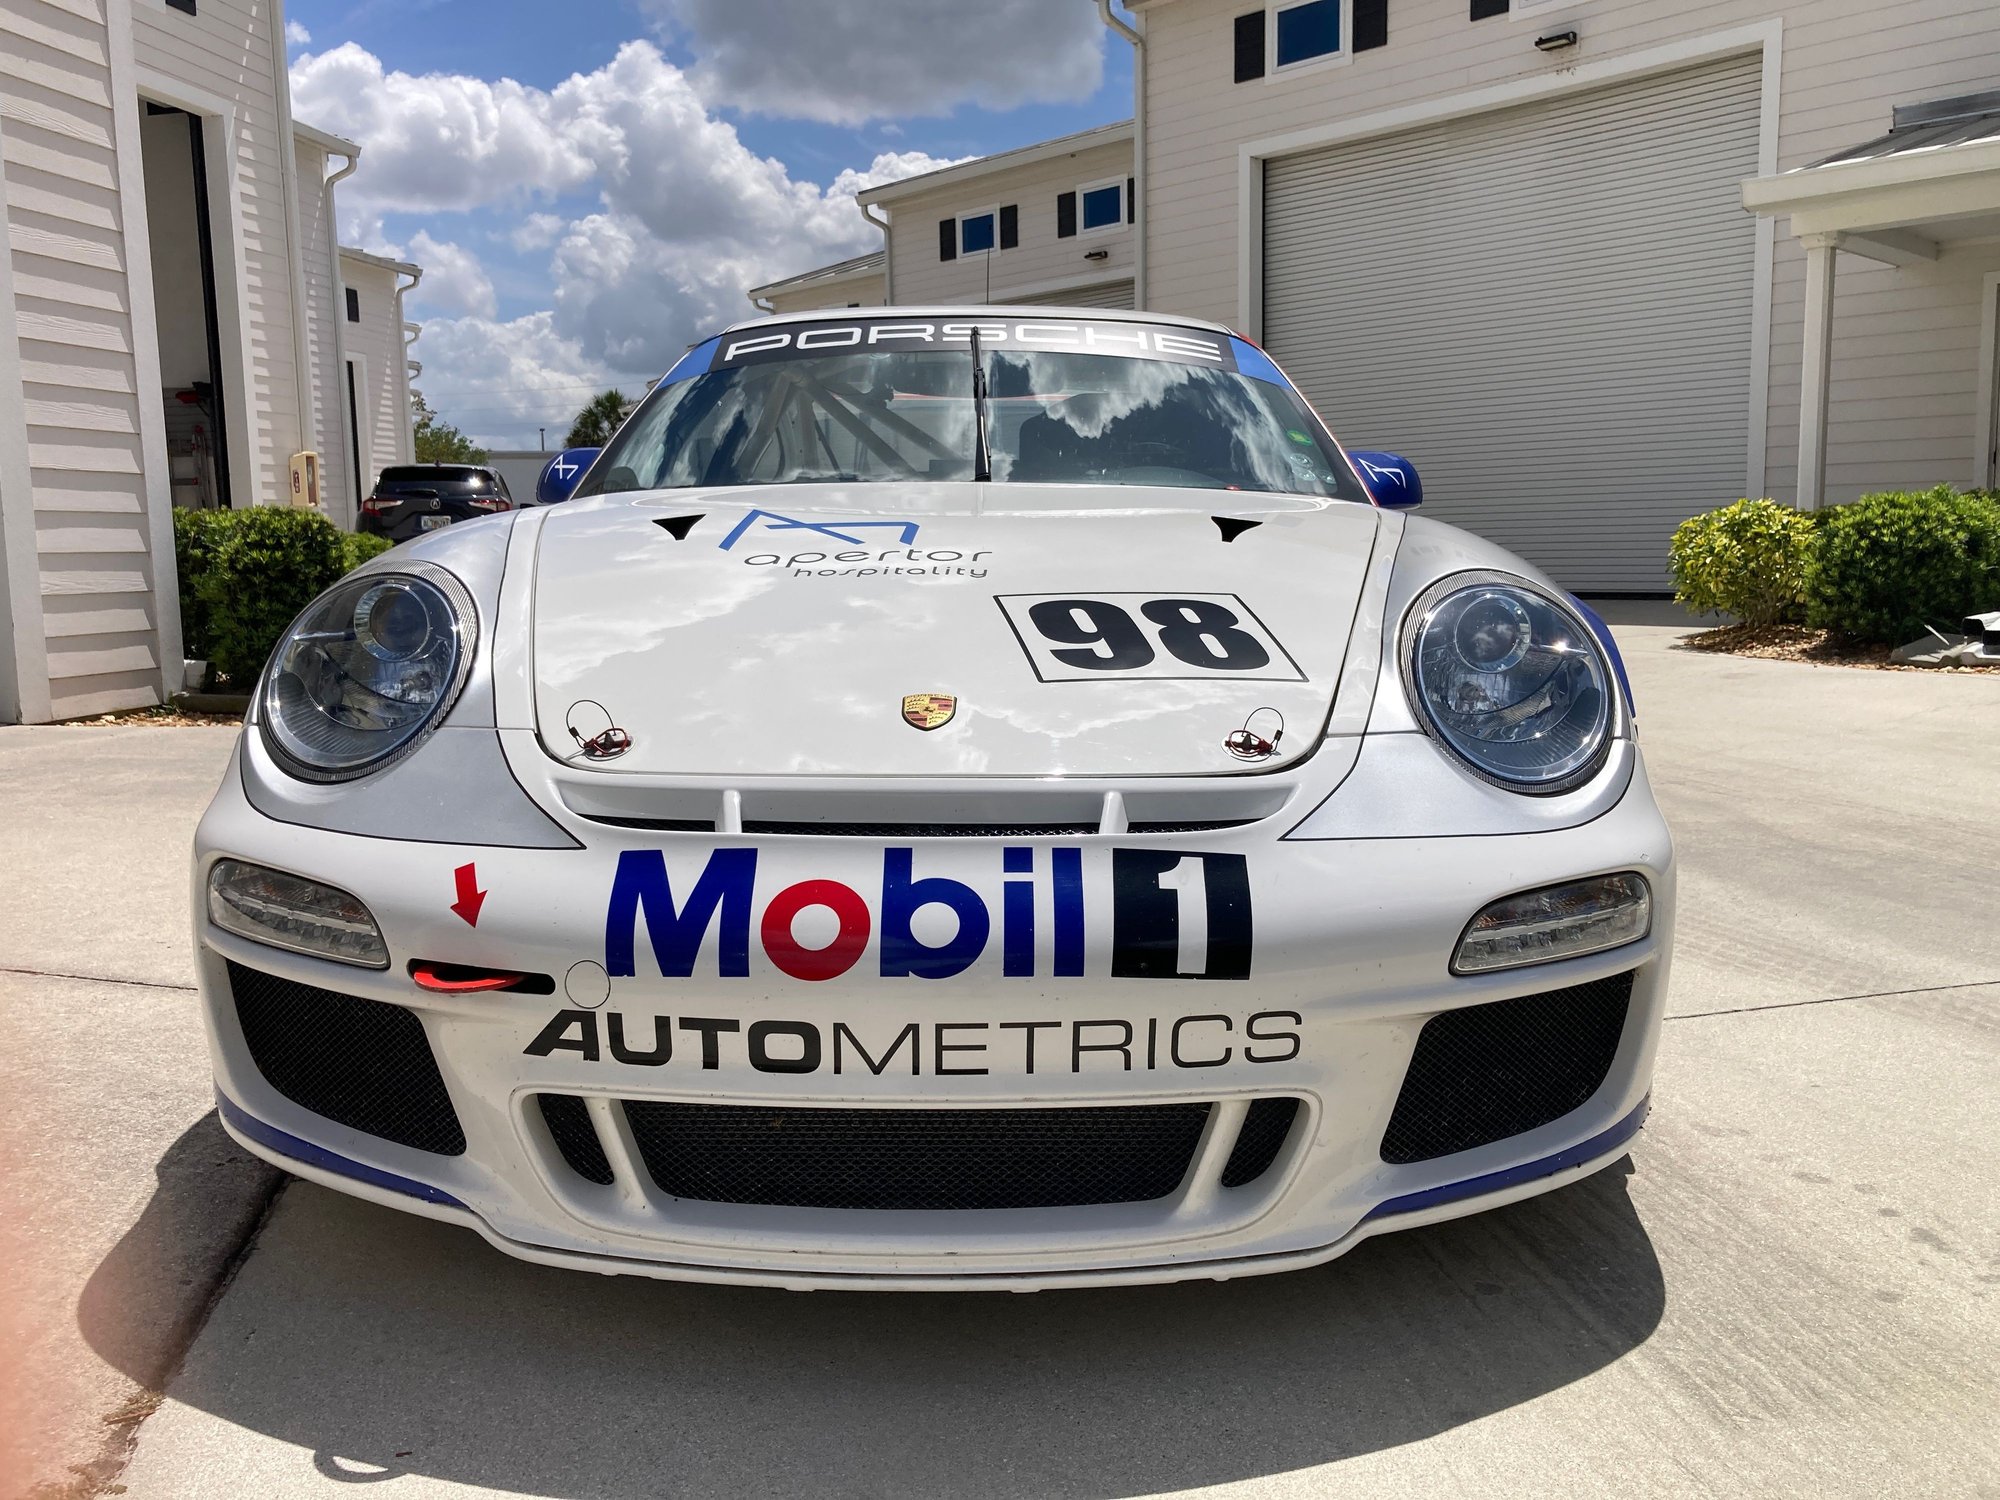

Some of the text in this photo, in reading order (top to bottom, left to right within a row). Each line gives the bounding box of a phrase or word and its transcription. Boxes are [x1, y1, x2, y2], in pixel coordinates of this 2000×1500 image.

[724, 323, 1223, 362] PORSCHE
[744, 549, 993, 568] apertor
[793, 566, 988, 578] hospitality
[1028, 599, 1270, 670] 98
[605, 847, 1206, 981] Mobil 1
[523, 1009, 1302, 1075] AUTOMETRICS
